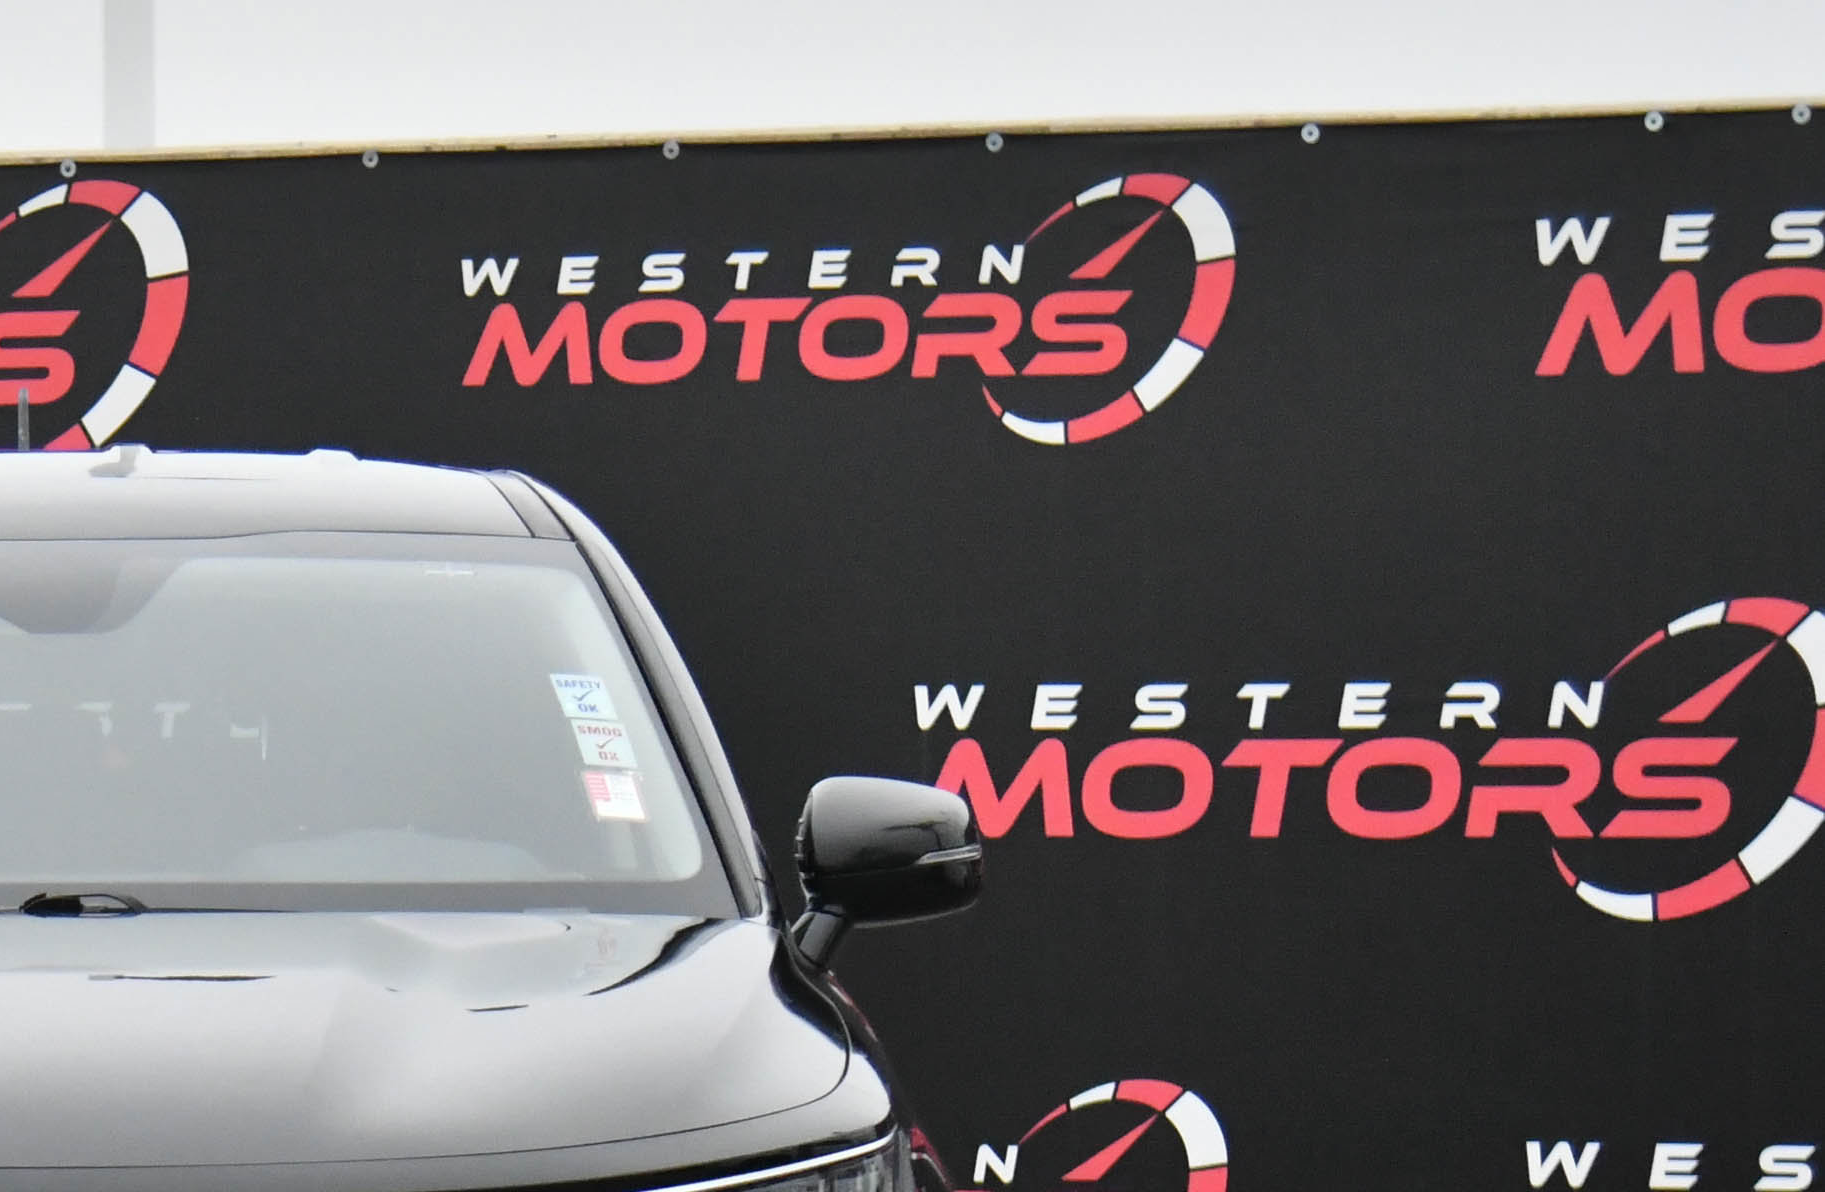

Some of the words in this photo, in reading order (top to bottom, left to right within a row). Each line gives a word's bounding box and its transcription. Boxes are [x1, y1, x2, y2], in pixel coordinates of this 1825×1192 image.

[1535, 210, 1825, 267] WES
[460, 244, 1026, 299] WESTERN
[461, 289, 1133, 388] MOTORS
[555, 678, 601, 689] SAFETY
[577, 703, 599, 713] OK
[913, 680, 1606, 731] WESTERN
[577, 725, 622, 737] SMOG
[598, 751, 620, 761] OK
[935, 737, 1738, 840] MOTORS
